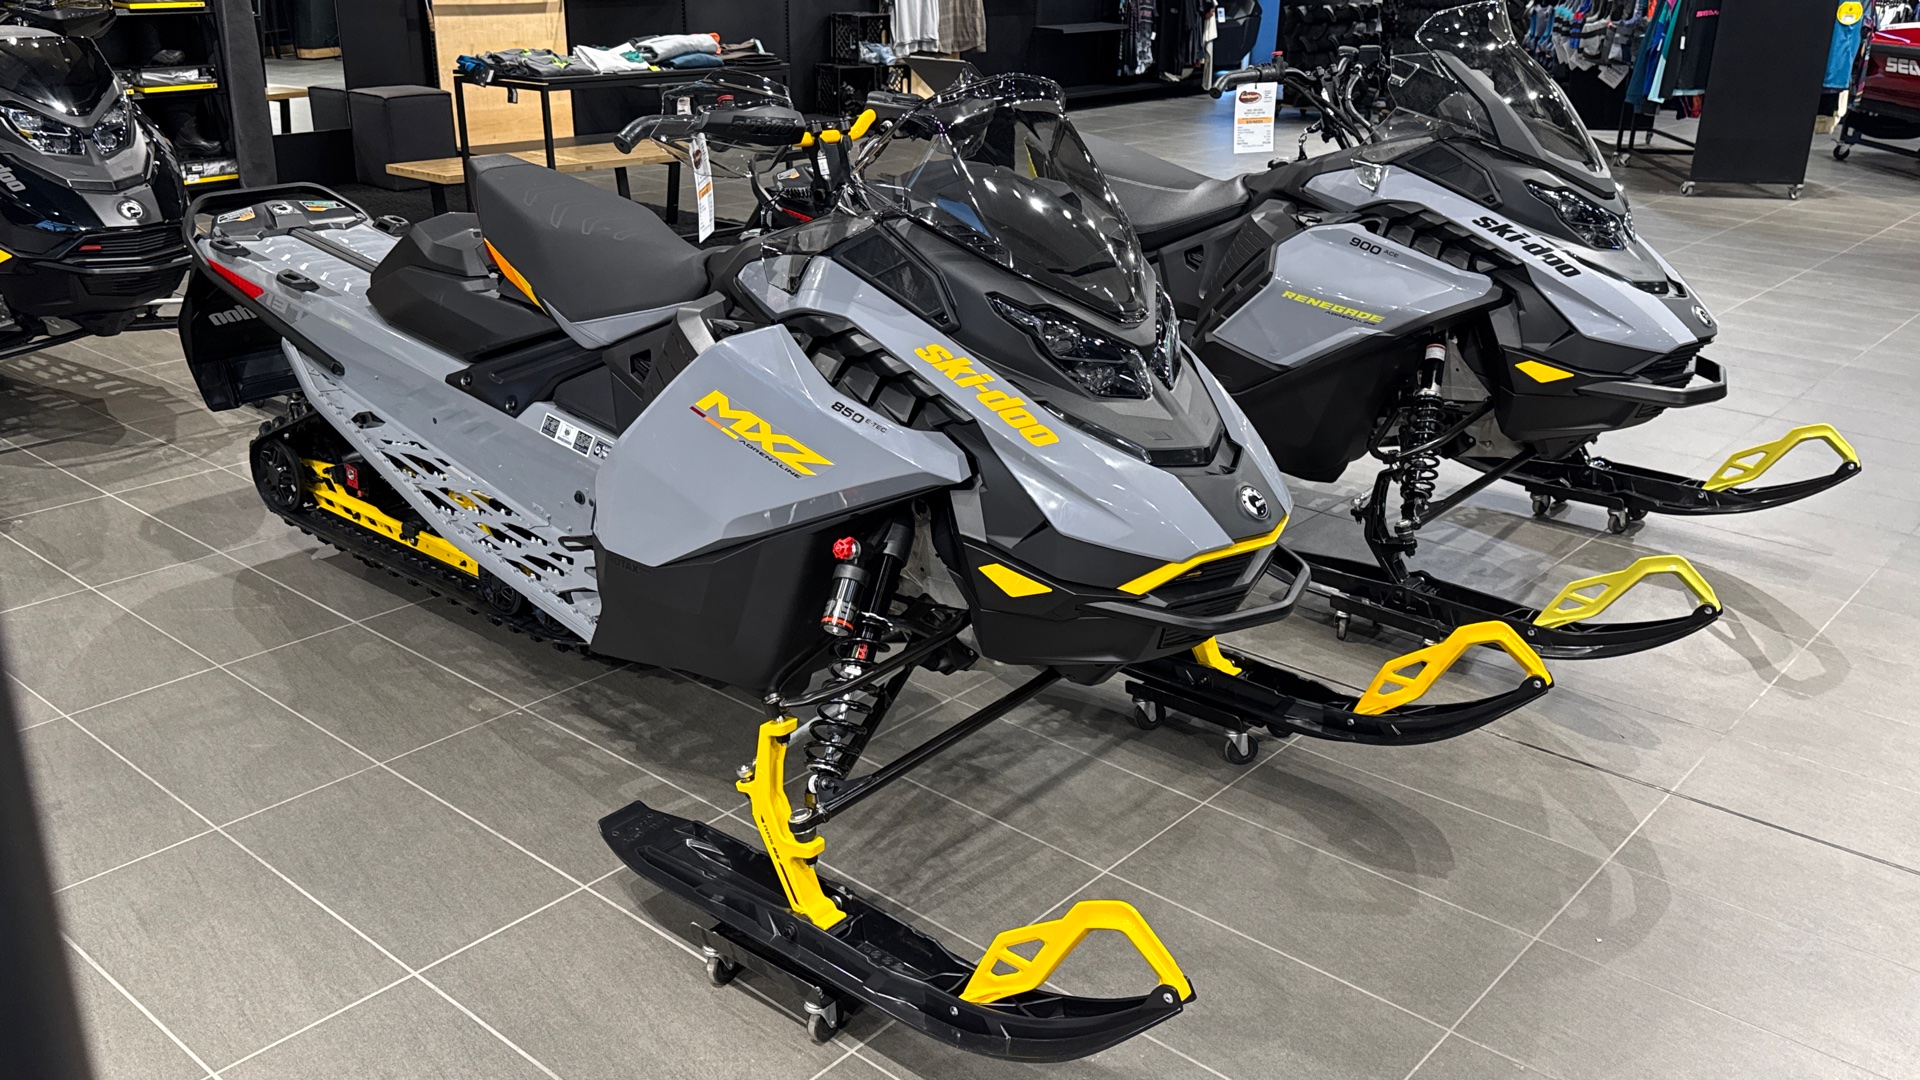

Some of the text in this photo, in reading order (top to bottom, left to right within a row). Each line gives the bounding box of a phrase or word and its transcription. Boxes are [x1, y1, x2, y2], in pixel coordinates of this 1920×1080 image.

[1349, 236, 1400, 259] 900 ACE
[1471, 216, 1582, 278] ski-doo
[1281, 290, 1386, 323] RENEGADE
[1324, 310, 1377, 327] ADRENALINE
[914, 343, 1060, 447] ski-doo
[695, 389, 835, 476] MXZ
[831, 401, 888, 433] 850 E-TEC
[738, 439, 803, 480] ADRENALINE
